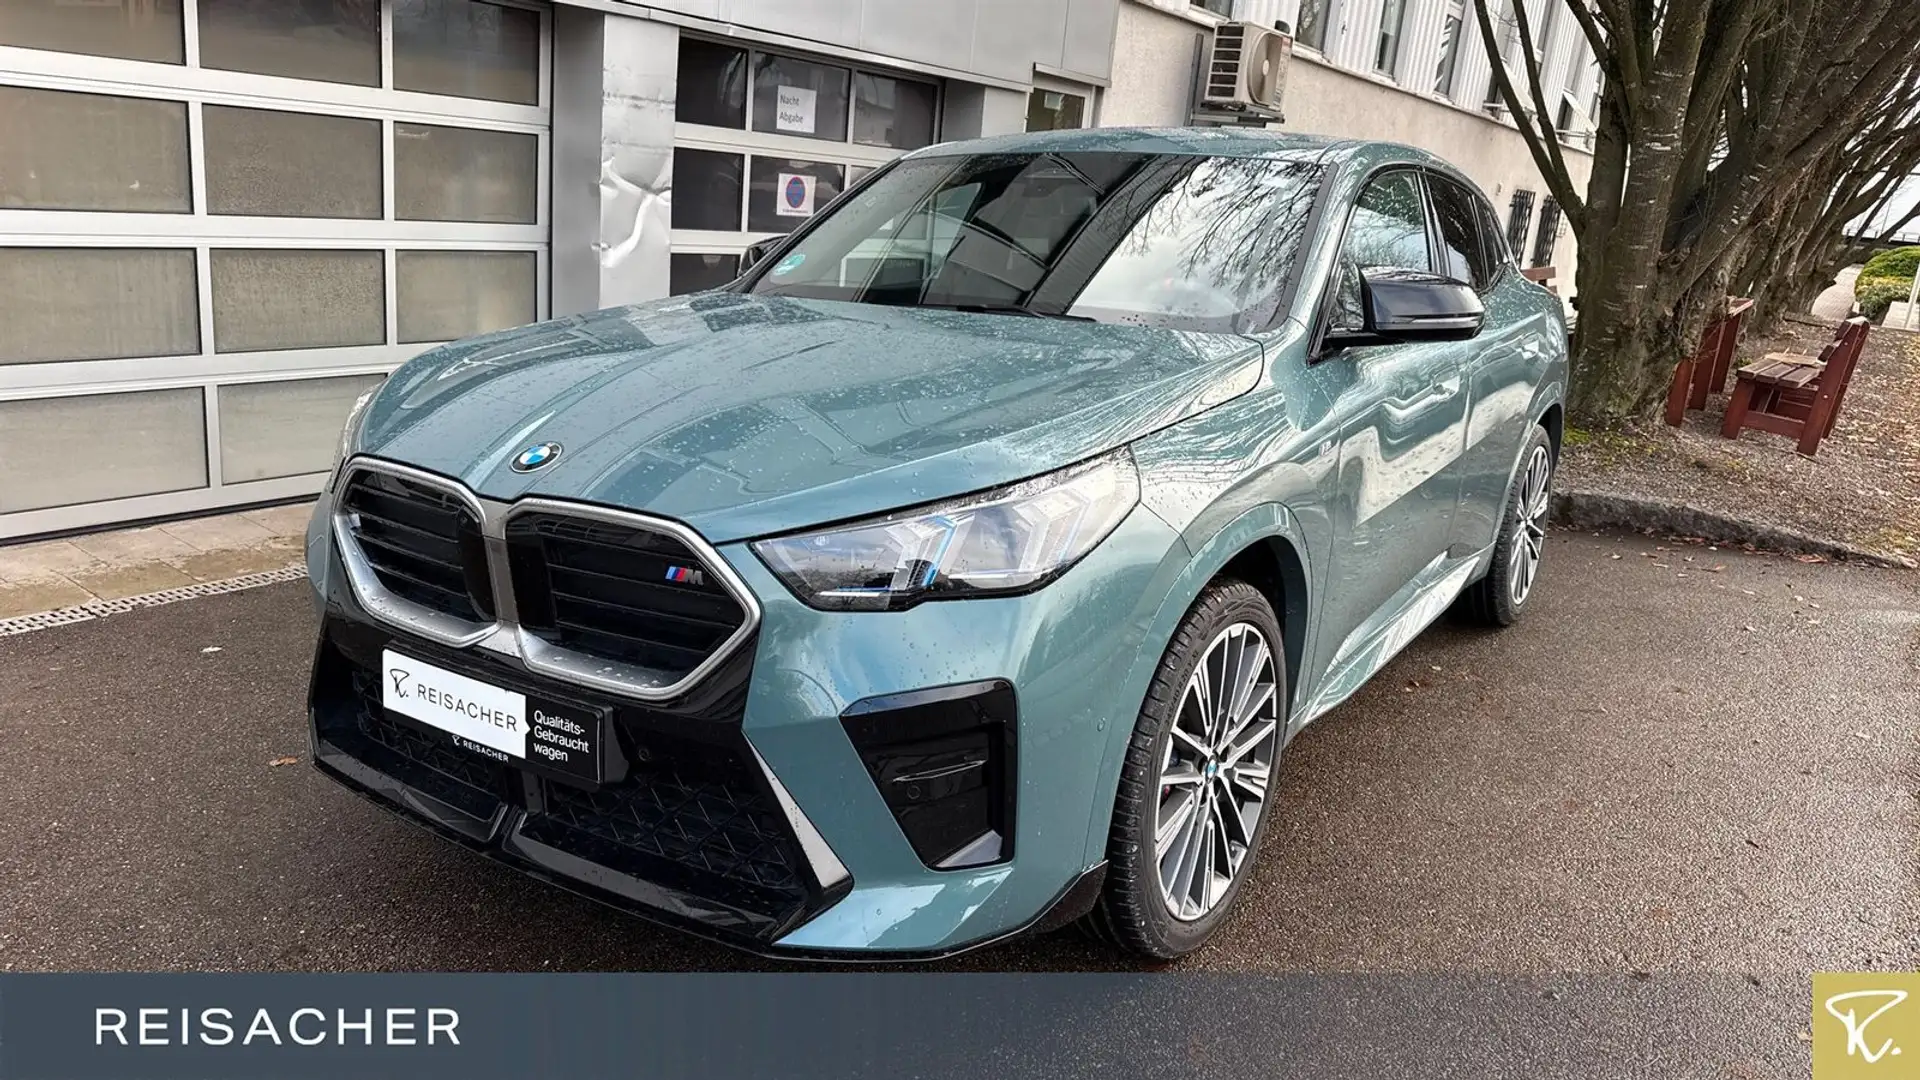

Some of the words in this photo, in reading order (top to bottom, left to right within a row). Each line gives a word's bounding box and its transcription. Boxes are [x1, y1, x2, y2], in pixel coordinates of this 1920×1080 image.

[780, 94, 800, 106] Nacht
[779, 111, 804, 124] Abgabe
[417, 683, 518, 732] REISACHER
[533, 710, 585, 735] Qualitäts-
[533, 725, 590, 753] Gebraucht
[463, 740, 509, 763] REISACHER
[533, 743, 568, 762] wagen
